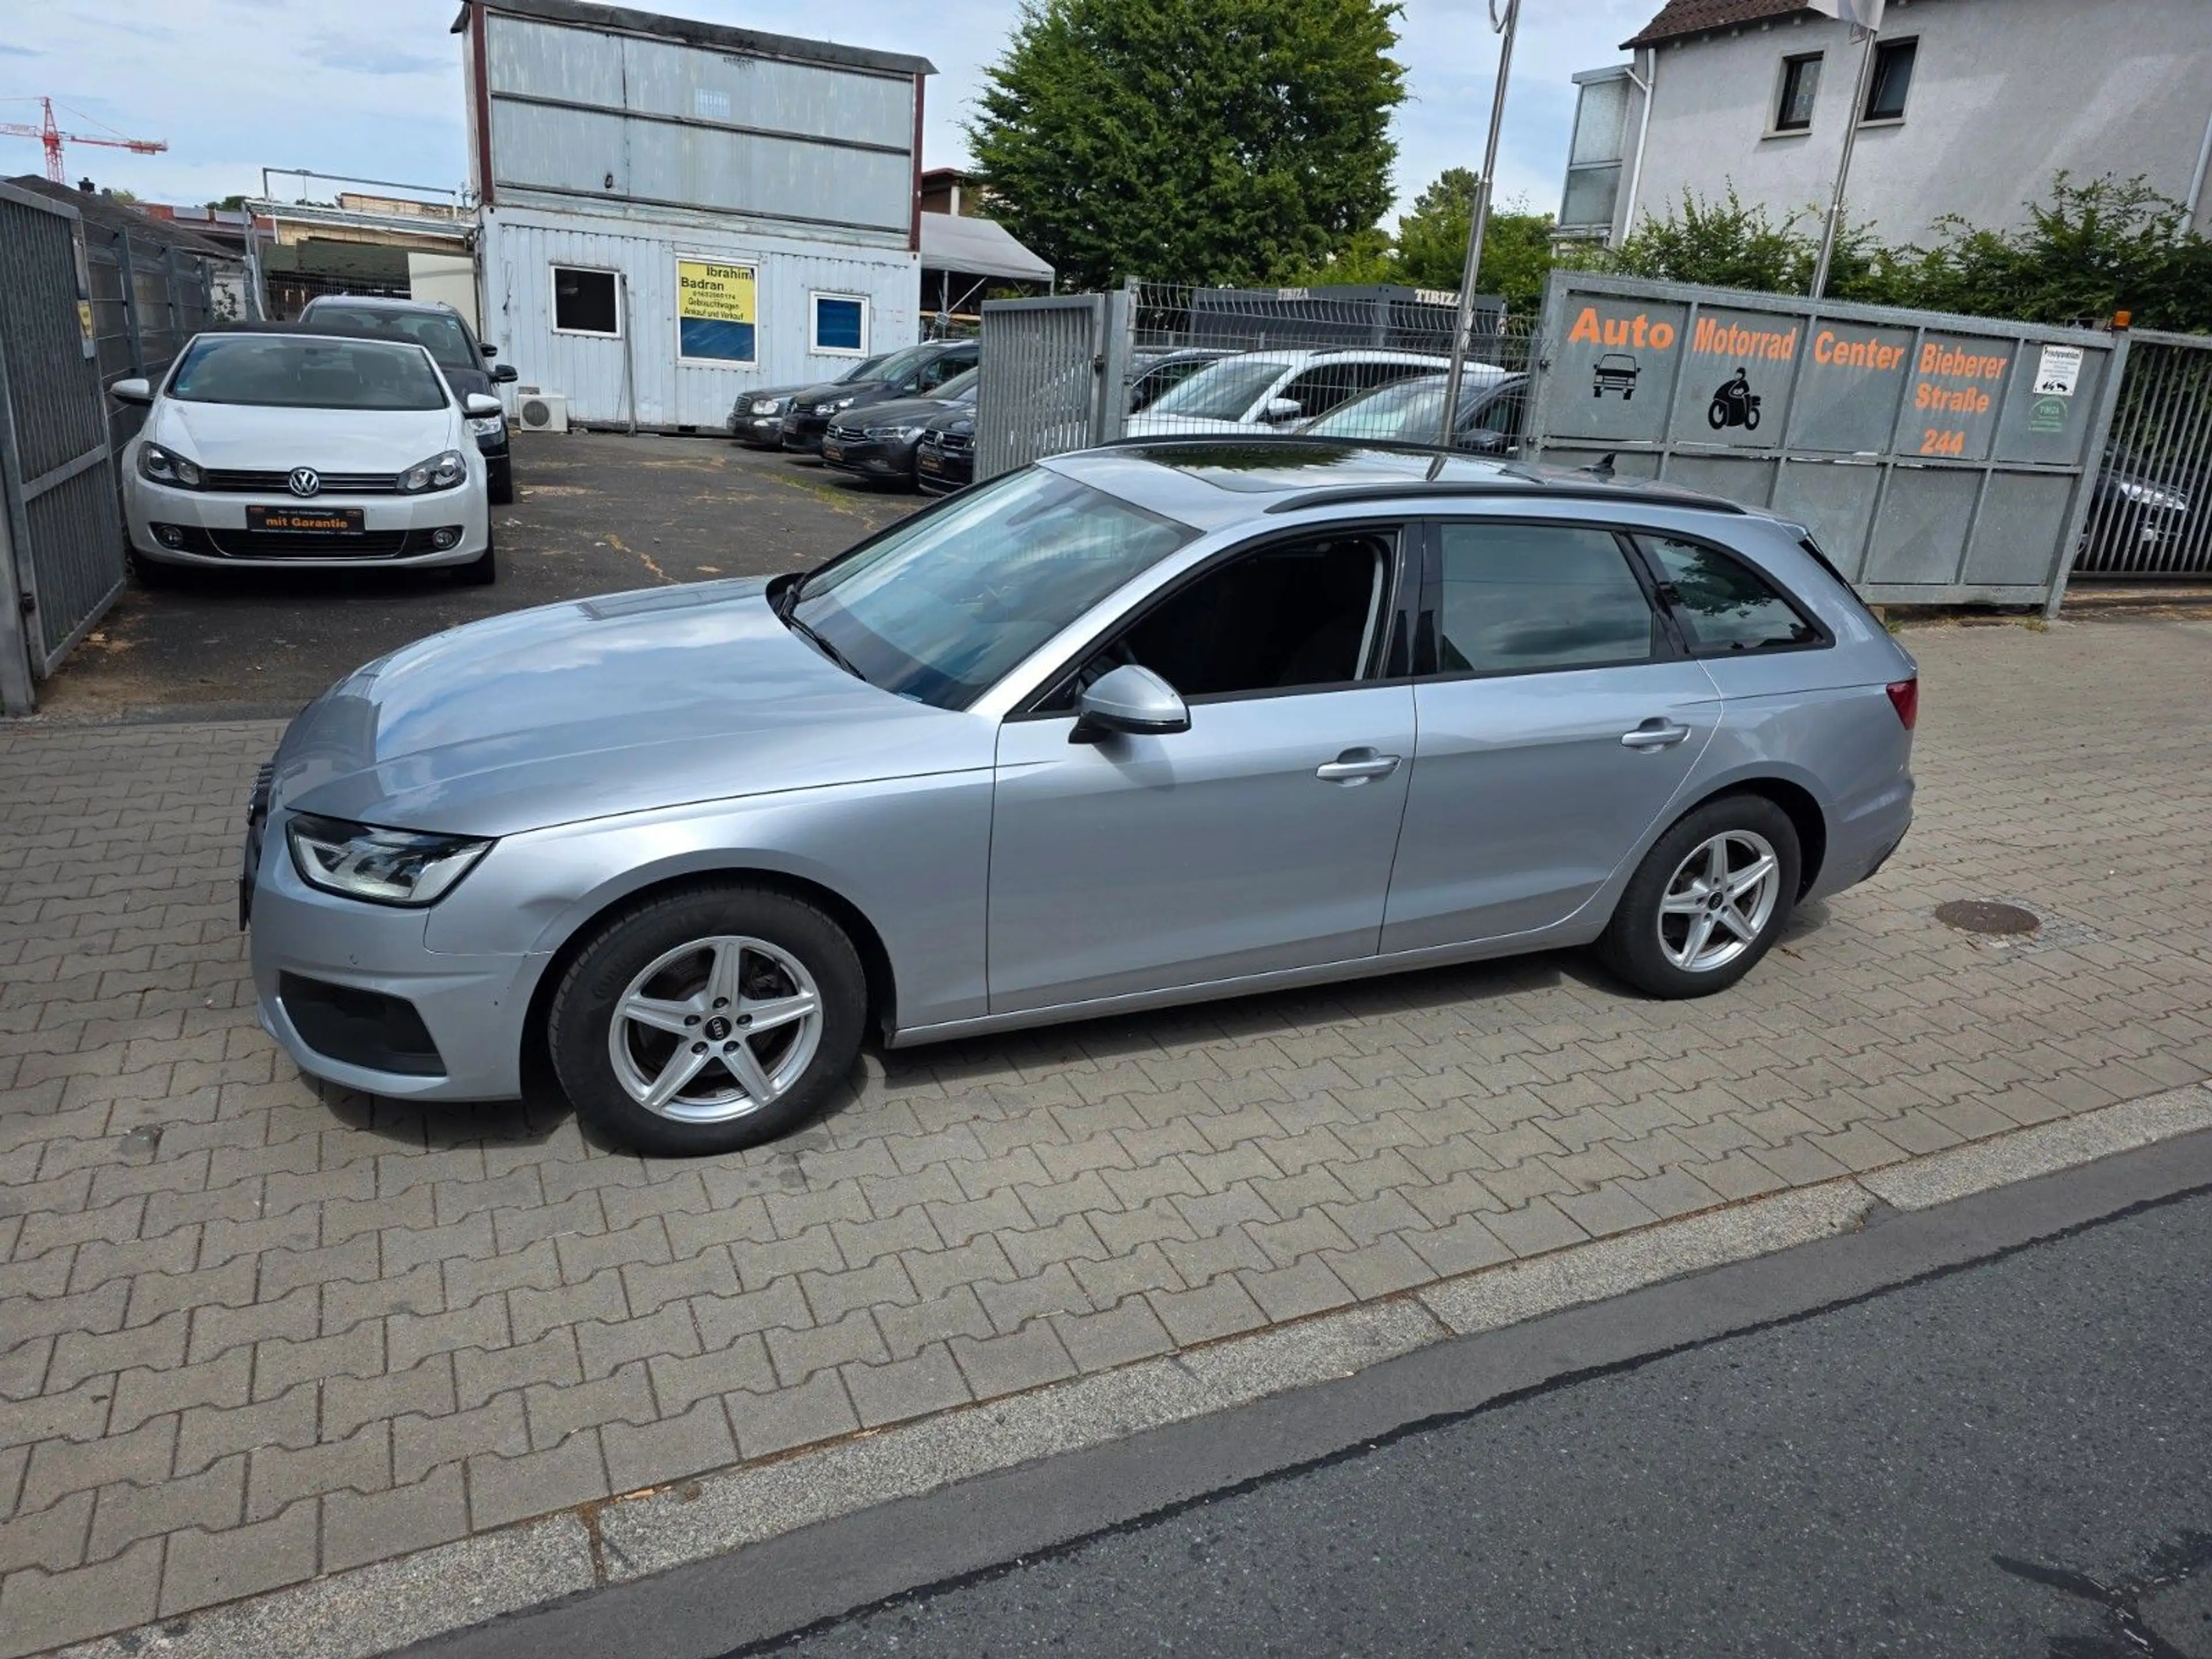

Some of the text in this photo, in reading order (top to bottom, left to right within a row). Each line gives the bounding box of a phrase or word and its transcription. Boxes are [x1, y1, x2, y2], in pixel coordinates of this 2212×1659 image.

[681, 276, 724, 291] Badran
[706, 266, 753, 280] Ibrahim
[1568, 308, 1904, 369] Auto Motorrad Center
[1920, 343, 2007, 378] Bieberer
[1915, 382, 1990, 413] Straße
[1920, 429, 1965, 455] 244
[266, 516, 348, 529] mit Garantie
